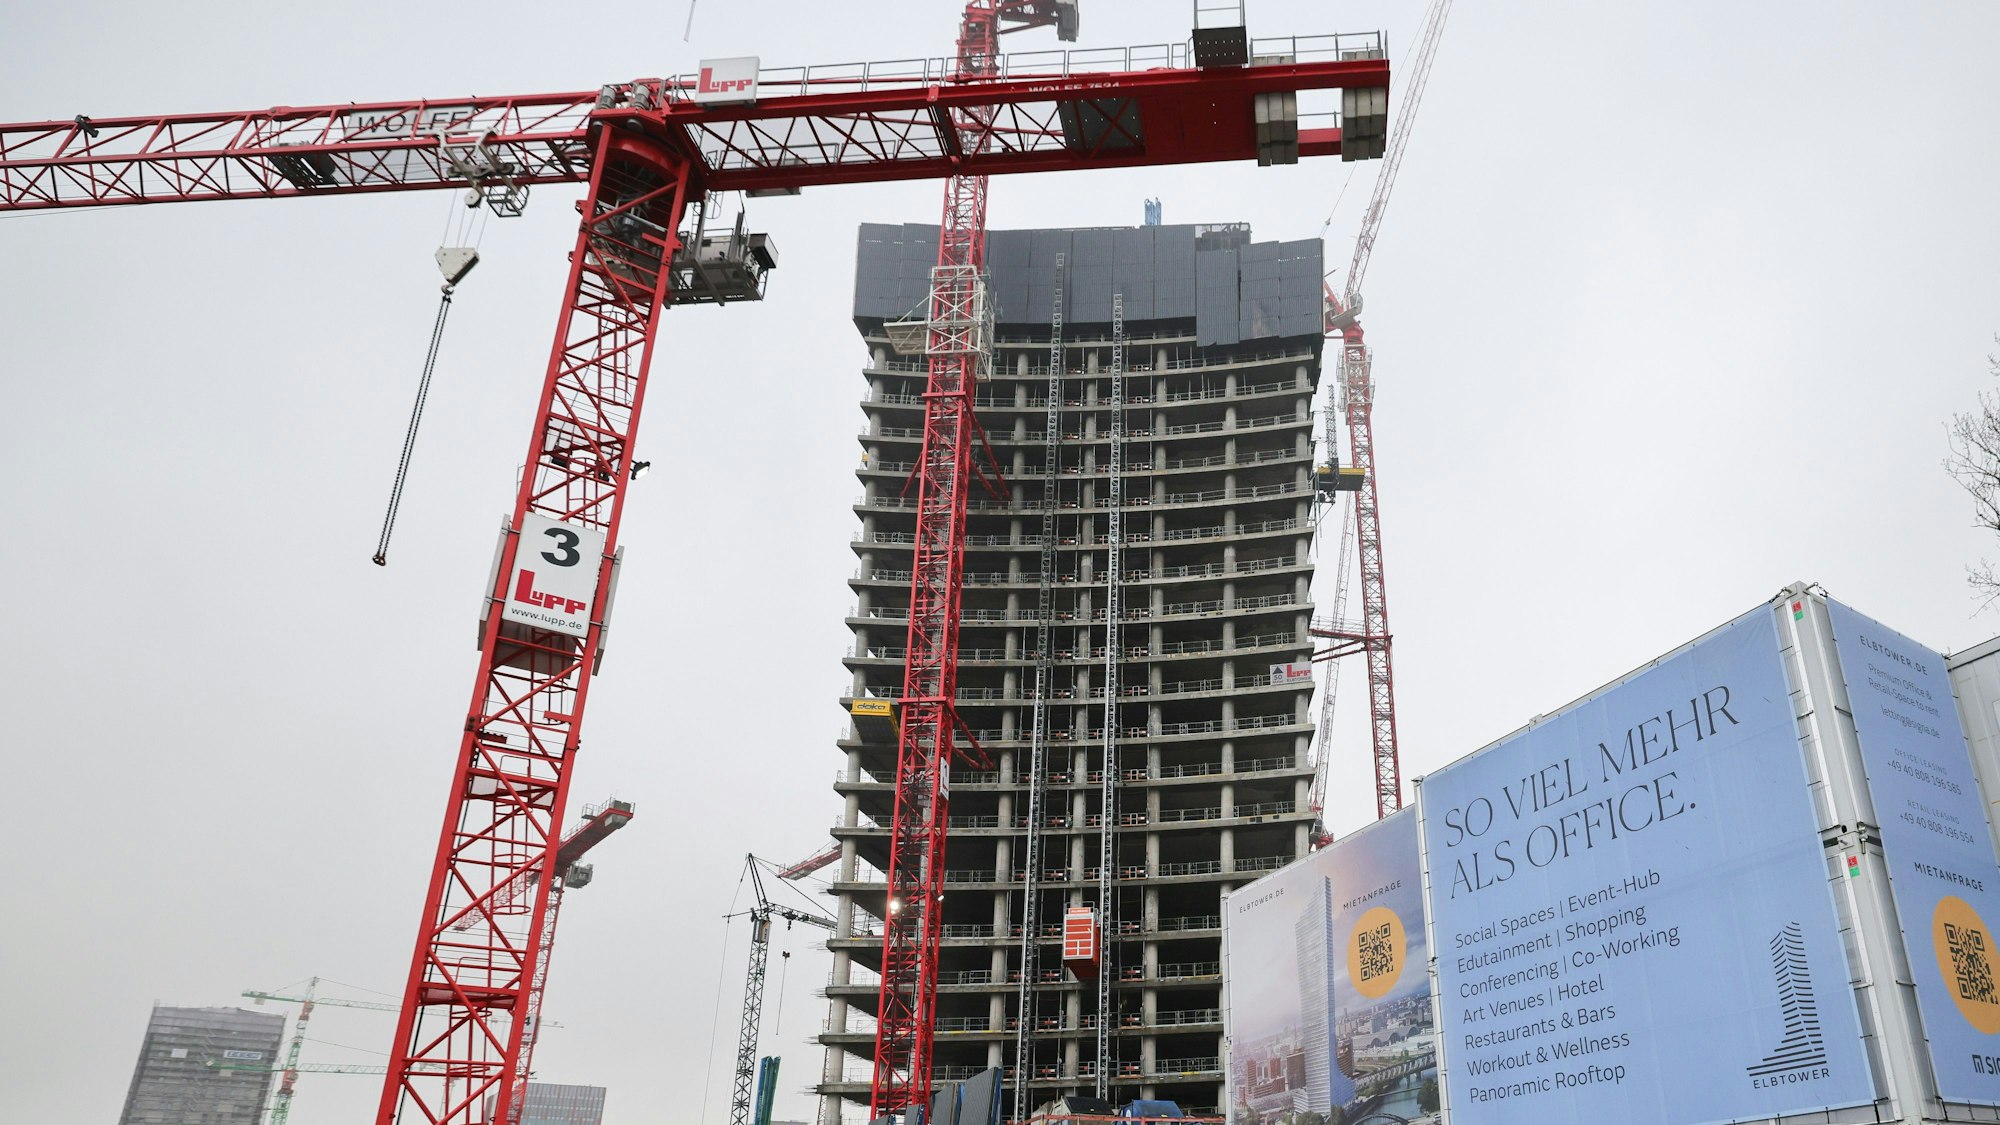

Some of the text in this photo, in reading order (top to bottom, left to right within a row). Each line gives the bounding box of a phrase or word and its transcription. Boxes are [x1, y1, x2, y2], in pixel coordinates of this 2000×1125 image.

[540, 527, 580, 567] 3
[511, 607, 582, 630] www.lupp.de
[1859, 635, 1928, 676] ELBTOWER.DE
[1867, 663, 1902, 687] Premium
[1902, 679, 1925, 699] Office
[1867, 677, 1917, 709] Retail-Space
[1445, 685, 1740, 848] SO VIEL MEHR
[1887, 760, 1903, 773] +49
[1903, 764, 1914, 777] 40
[1914, 768, 1931, 784] 808
[1894, 748, 1949, 777] OFFICE LEASING
[1899, 812, 1915, 825] +49
[1915, 817, 1928, 830] 40
[1927, 821, 1943, 835] 808
[1906, 799, 1961, 825] RETAIL LEASING
[1450, 771, 1697, 900] ALS OFFICE.
[1914, 861, 1984, 892] MIETANFRAGE
[1239, 887, 1286, 915] ELBTOWER.DE
[1343, 880, 1403, 912] MIETANFRAGE
[1455, 921, 1497, 949] Social
[1500, 905, 1556, 935] Spaces
[1568, 868, 1662, 913] Event-Hub
[1457, 932, 1553, 974] Edutainment
[1565, 904, 1648, 942] Shopping
[1460, 958, 1560, 999] Conferencing
[1572, 925, 1682, 968] Co-Working
[1462, 1006, 1487, 1025] Art
[1489, 991, 1546, 1018] Venues
[1557, 973, 1605, 1002] Hotel
[1465, 1004, 1617, 1050] Restaurants & Bars
[1467, 1032, 1631, 1077] Workout & Wellness
[1470, 1063, 1627, 1104] Panoramic Rooftop
[1753, 1067, 1831, 1090] ELBTOWER
